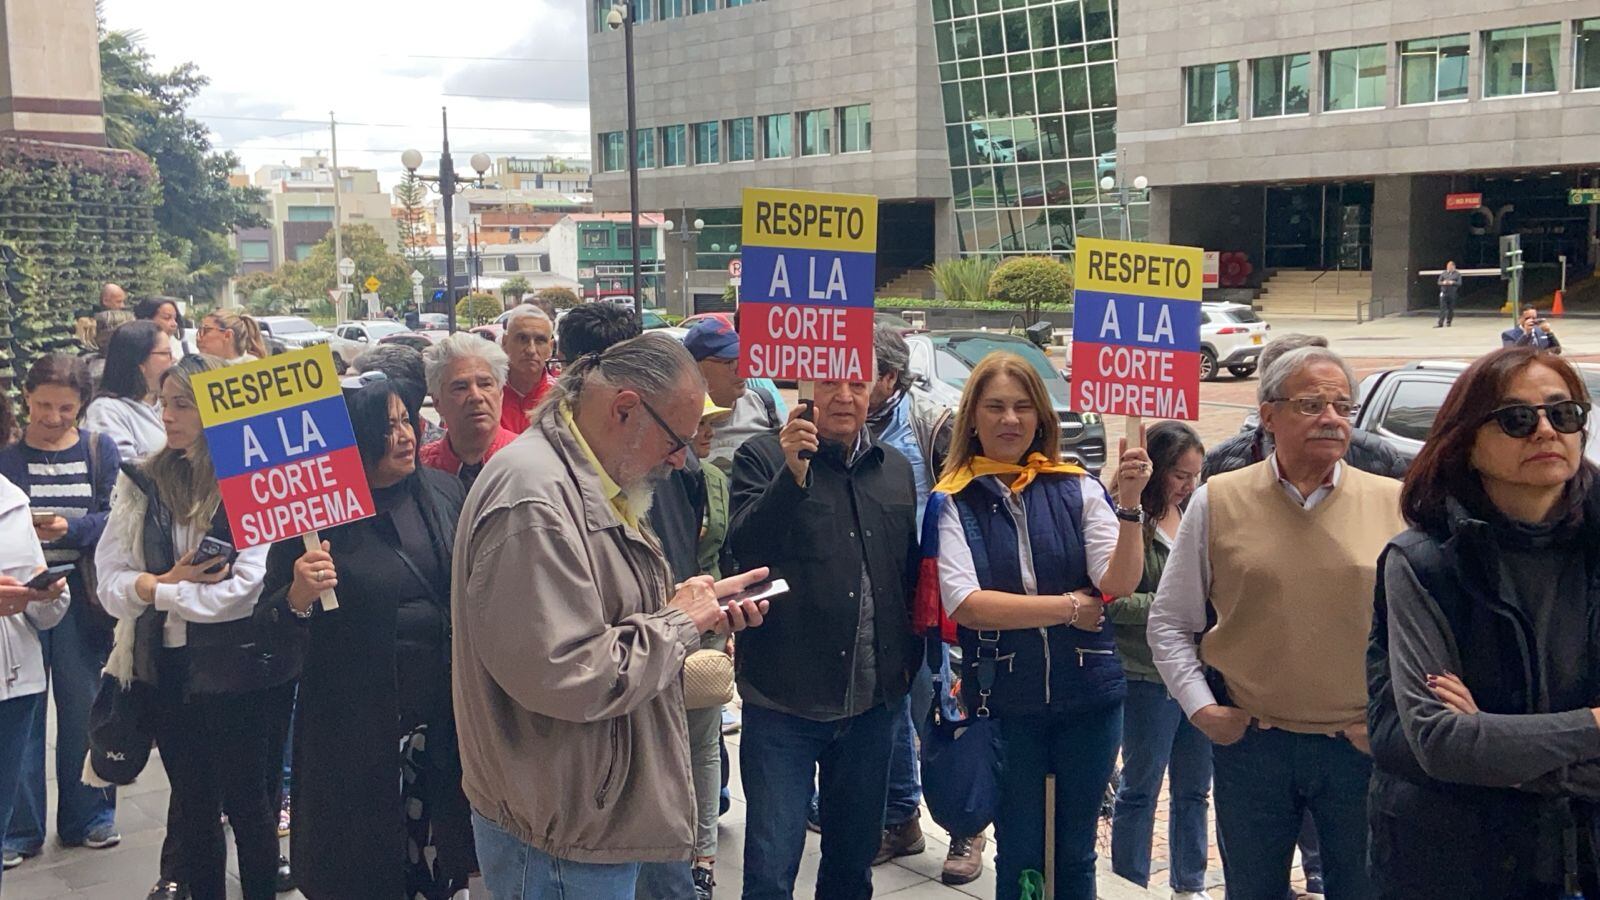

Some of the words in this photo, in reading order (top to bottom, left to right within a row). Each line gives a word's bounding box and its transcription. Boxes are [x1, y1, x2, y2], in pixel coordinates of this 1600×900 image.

[756, 200, 864, 240] RESPETO
[768, 254, 792, 298] A
[808, 256, 848, 301] LA
[1088, 250, 1191, 289] RESPETO
[768, 305, 847, 341] CORTE
[1099, 298, 1121, 340] A
[1137, 302, 1175, 345] LA
[749, 343, 863, 380] SUPREMA
[1098, 345, 1174, 382] CORTE
[207, 358, 323, 413] RESPETO
[1079, 380, 1189, 420] SUPREMA
[243, 424, 269, 467] A
[276, 409, 327, 457] LA
[250, 455, 338, 504] CORTE
[241, 487, 365, 546] SUPREMA
